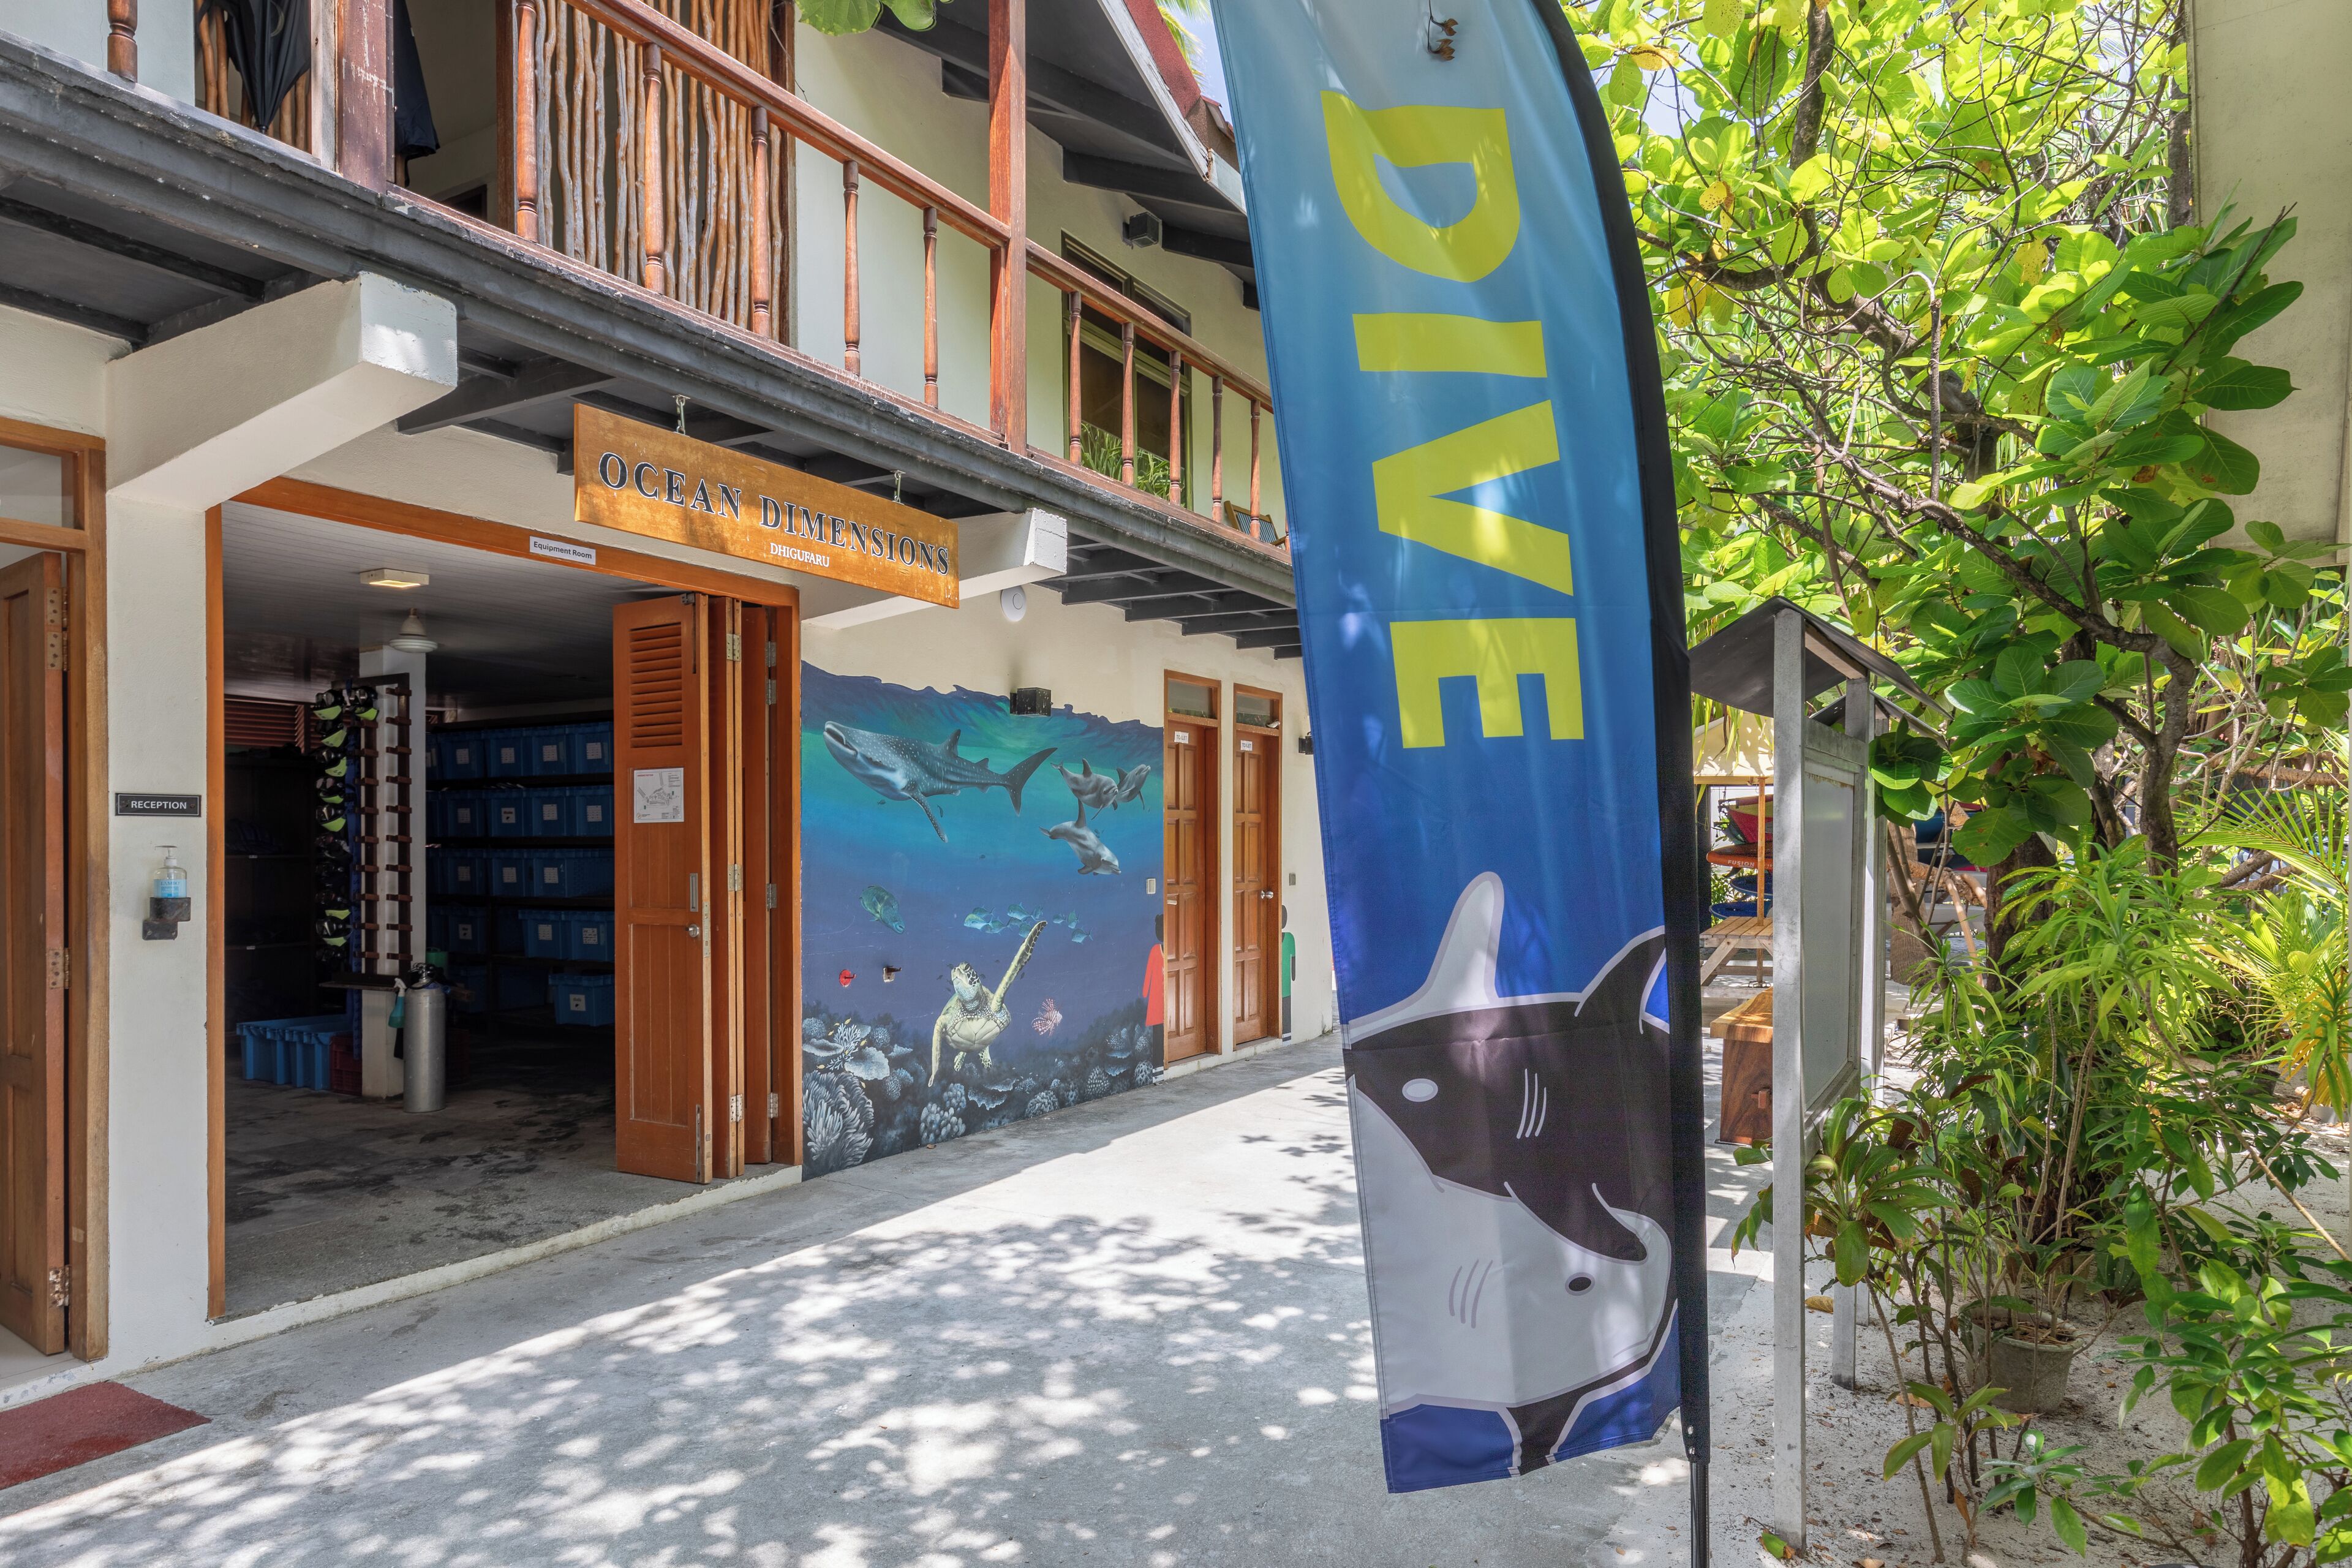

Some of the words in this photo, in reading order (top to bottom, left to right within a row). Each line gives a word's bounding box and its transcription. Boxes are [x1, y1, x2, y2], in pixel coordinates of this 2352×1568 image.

[1321, 90, 1584, 749] DIVE
[598, 451, 742, 521] OCEAN
[759, 494, 949, 576] DIMENSIONS
[533, 541, 571, 555] Equipment
[573, 549, 592, 559] Room
[770, 542, 830, 567] DHIGUFARU
[131, 801, 187, 809] RECEPTION
